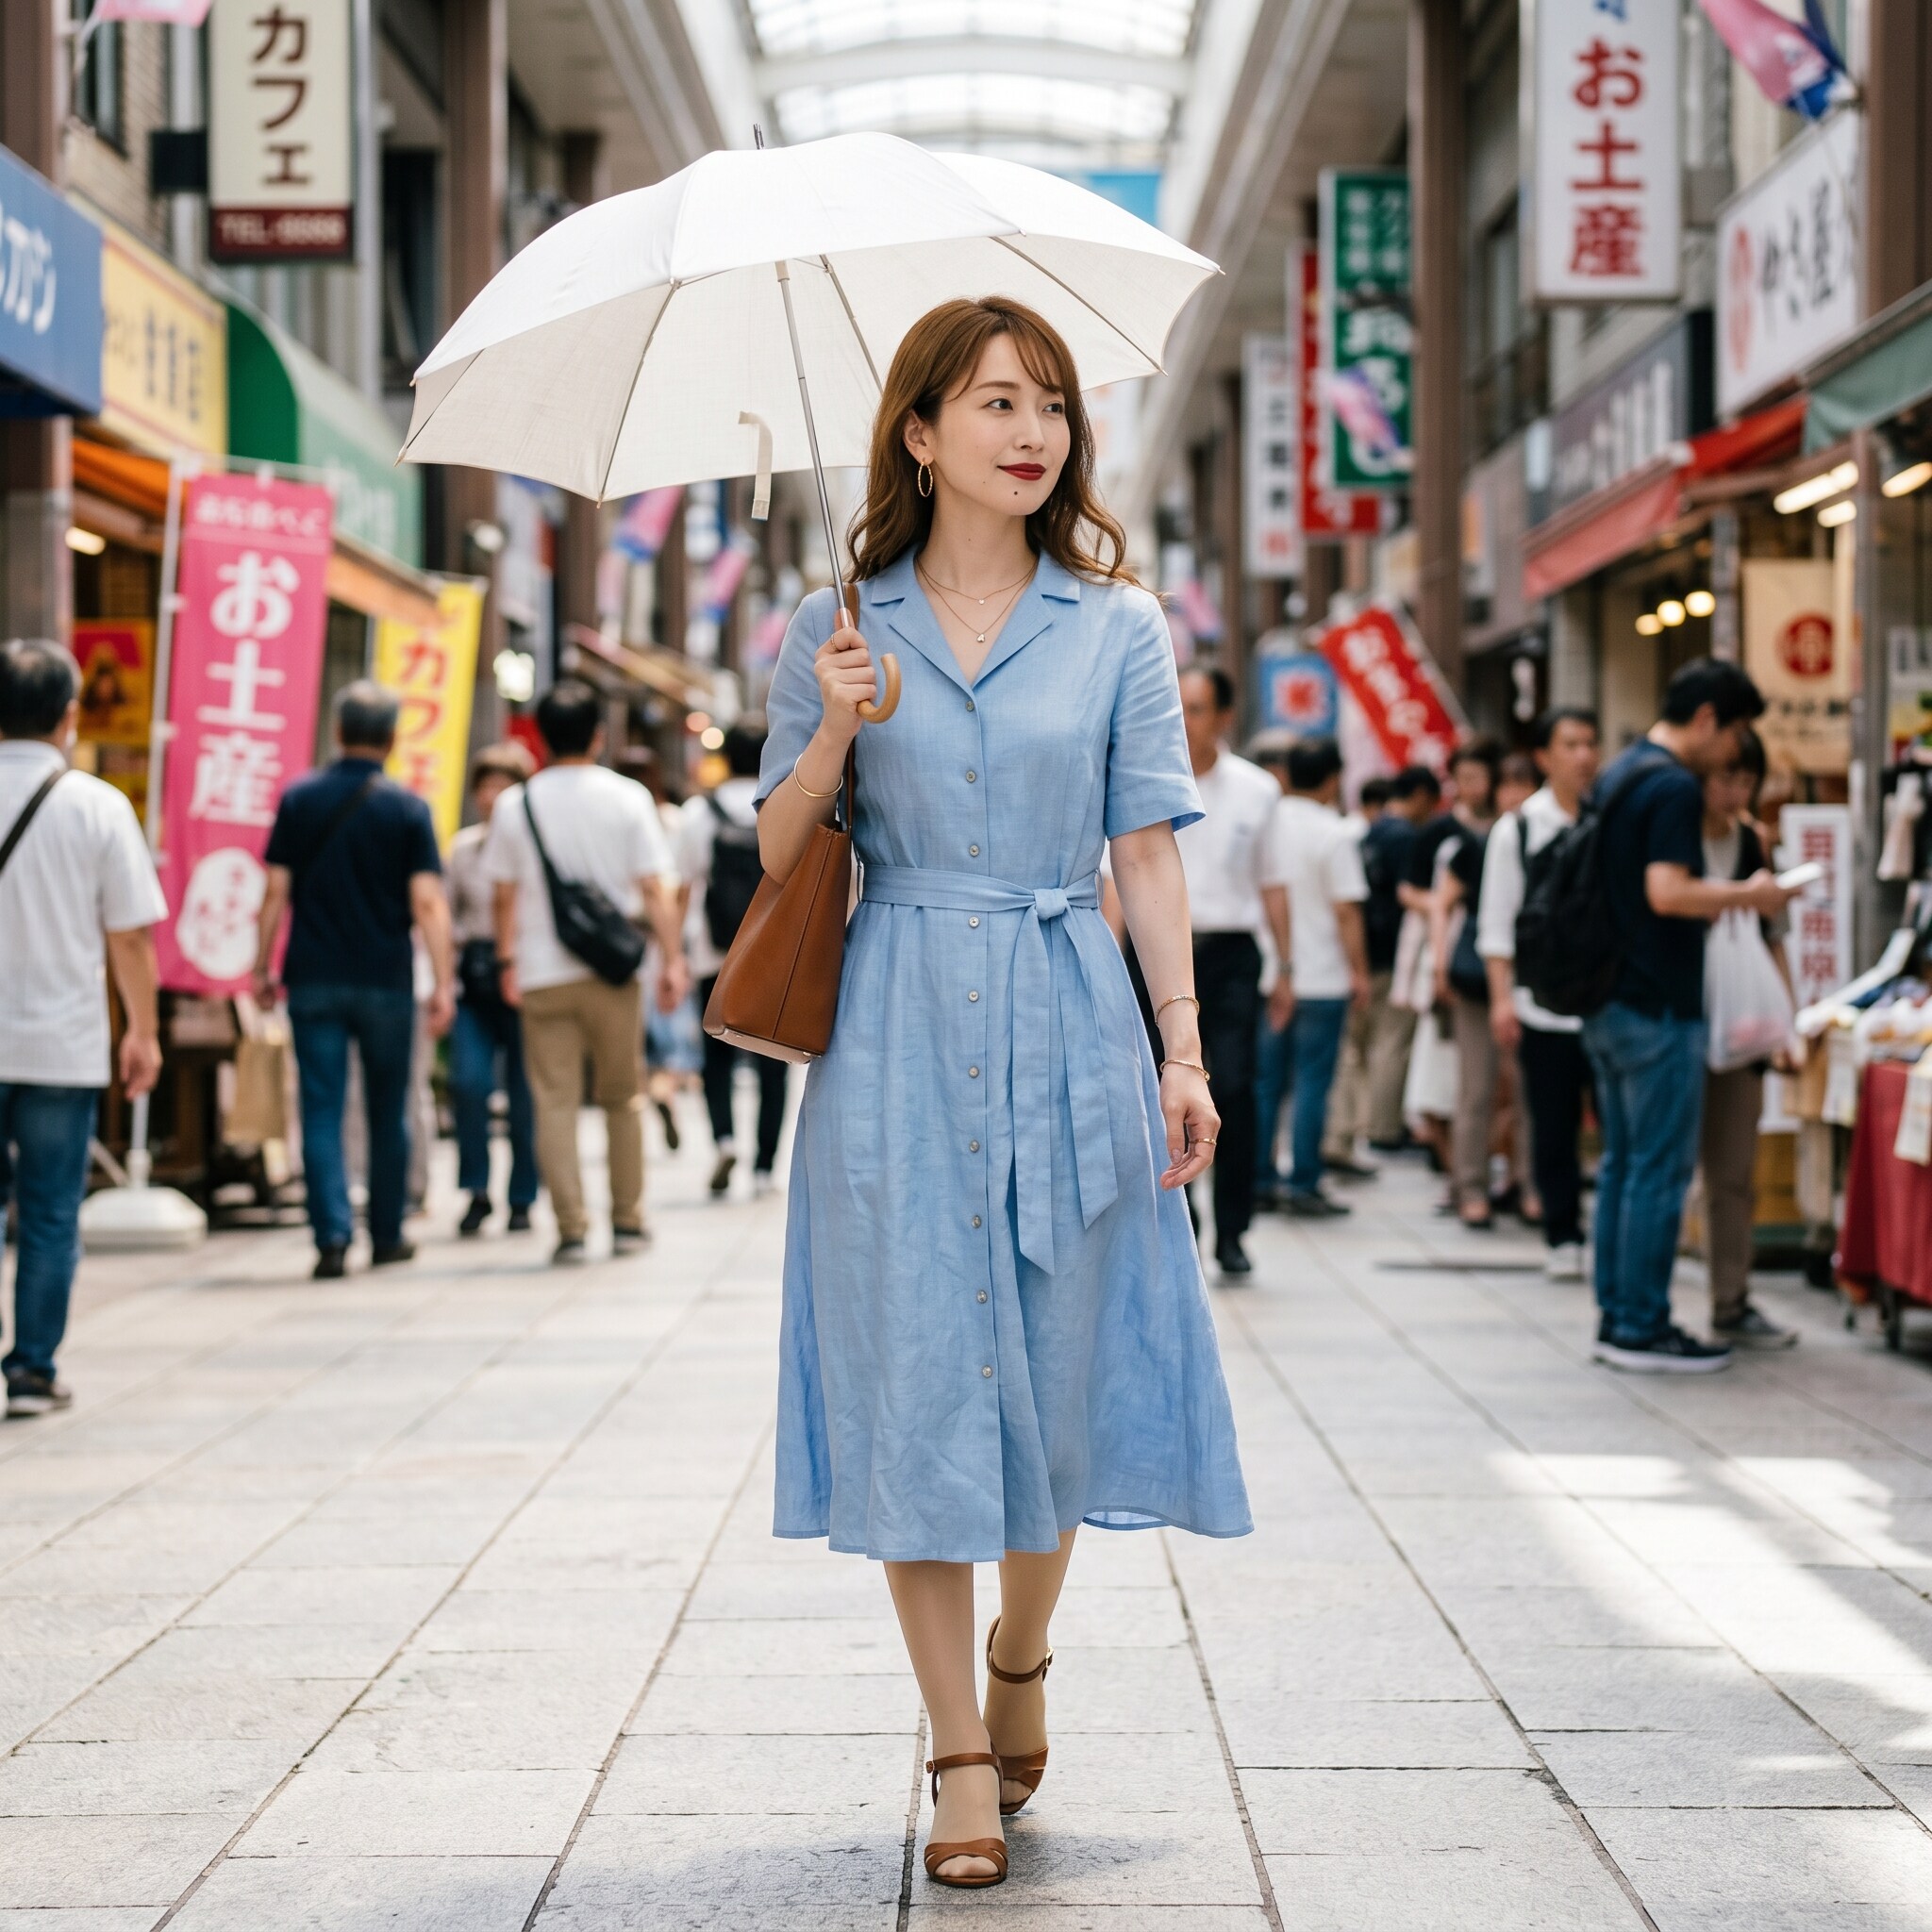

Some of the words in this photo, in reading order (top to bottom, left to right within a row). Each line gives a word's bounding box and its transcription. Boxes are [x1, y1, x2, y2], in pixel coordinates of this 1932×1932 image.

[250, 5, 311, 187] カフェ
[1569, 37, 1643, 277] お土産
[191, 550, 300, 826] お土産
